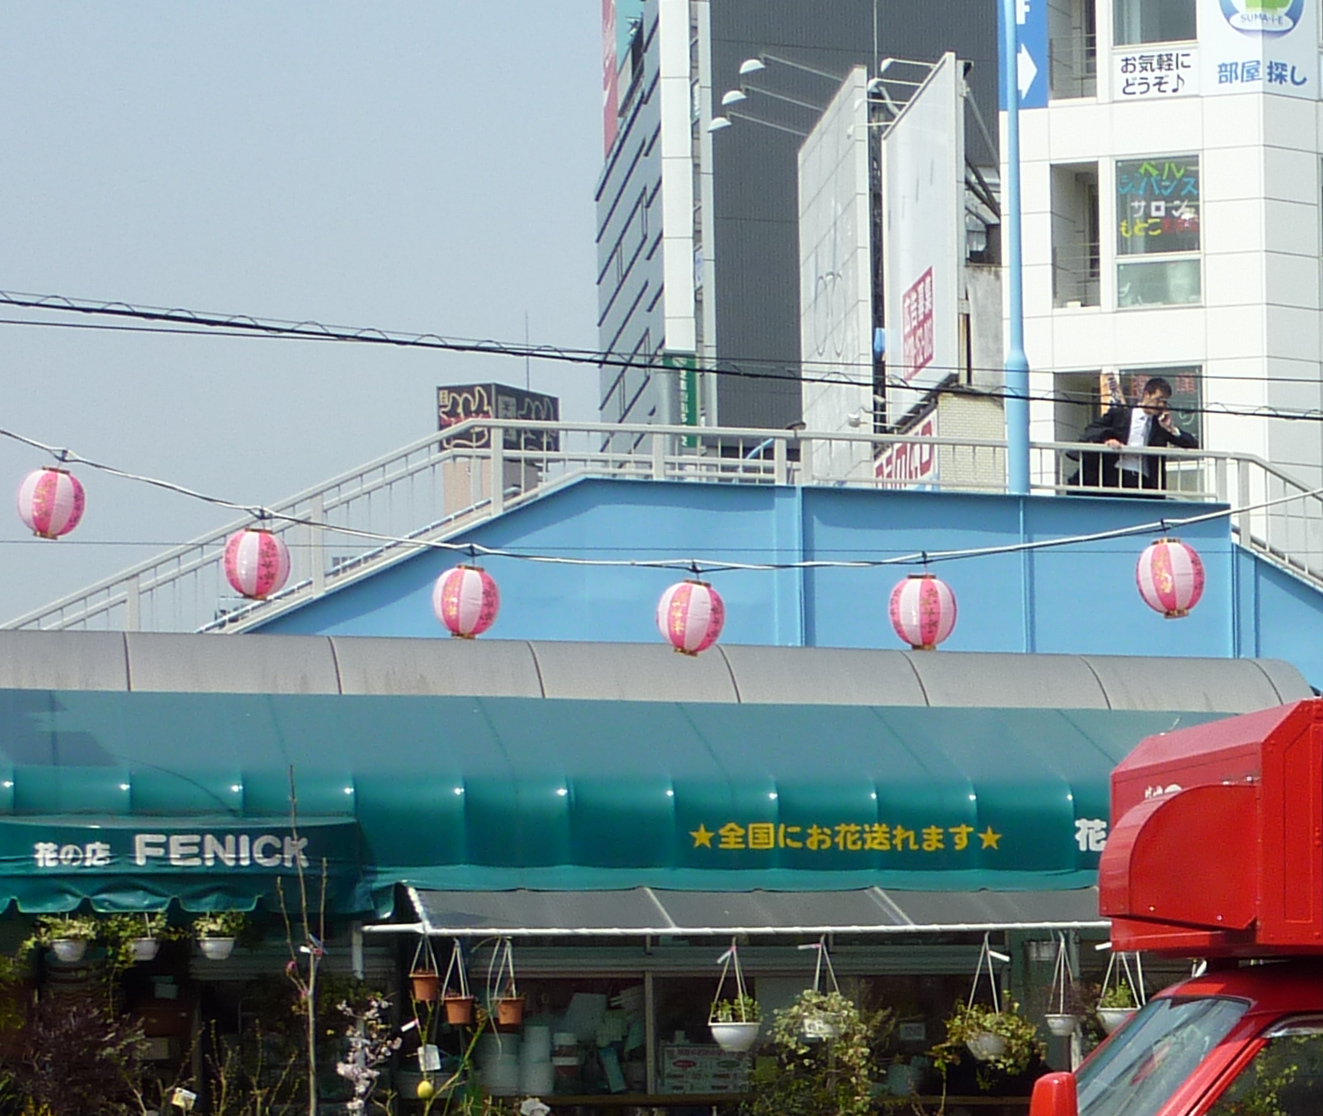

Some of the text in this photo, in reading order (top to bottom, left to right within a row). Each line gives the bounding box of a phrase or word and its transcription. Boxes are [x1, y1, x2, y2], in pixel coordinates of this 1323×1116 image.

[1121, 53, 1191, 74] お気軽に
[1217, 60, 1307, 86] 部屋探し
[34, 834, 309, 868] 花の店 FENICK
